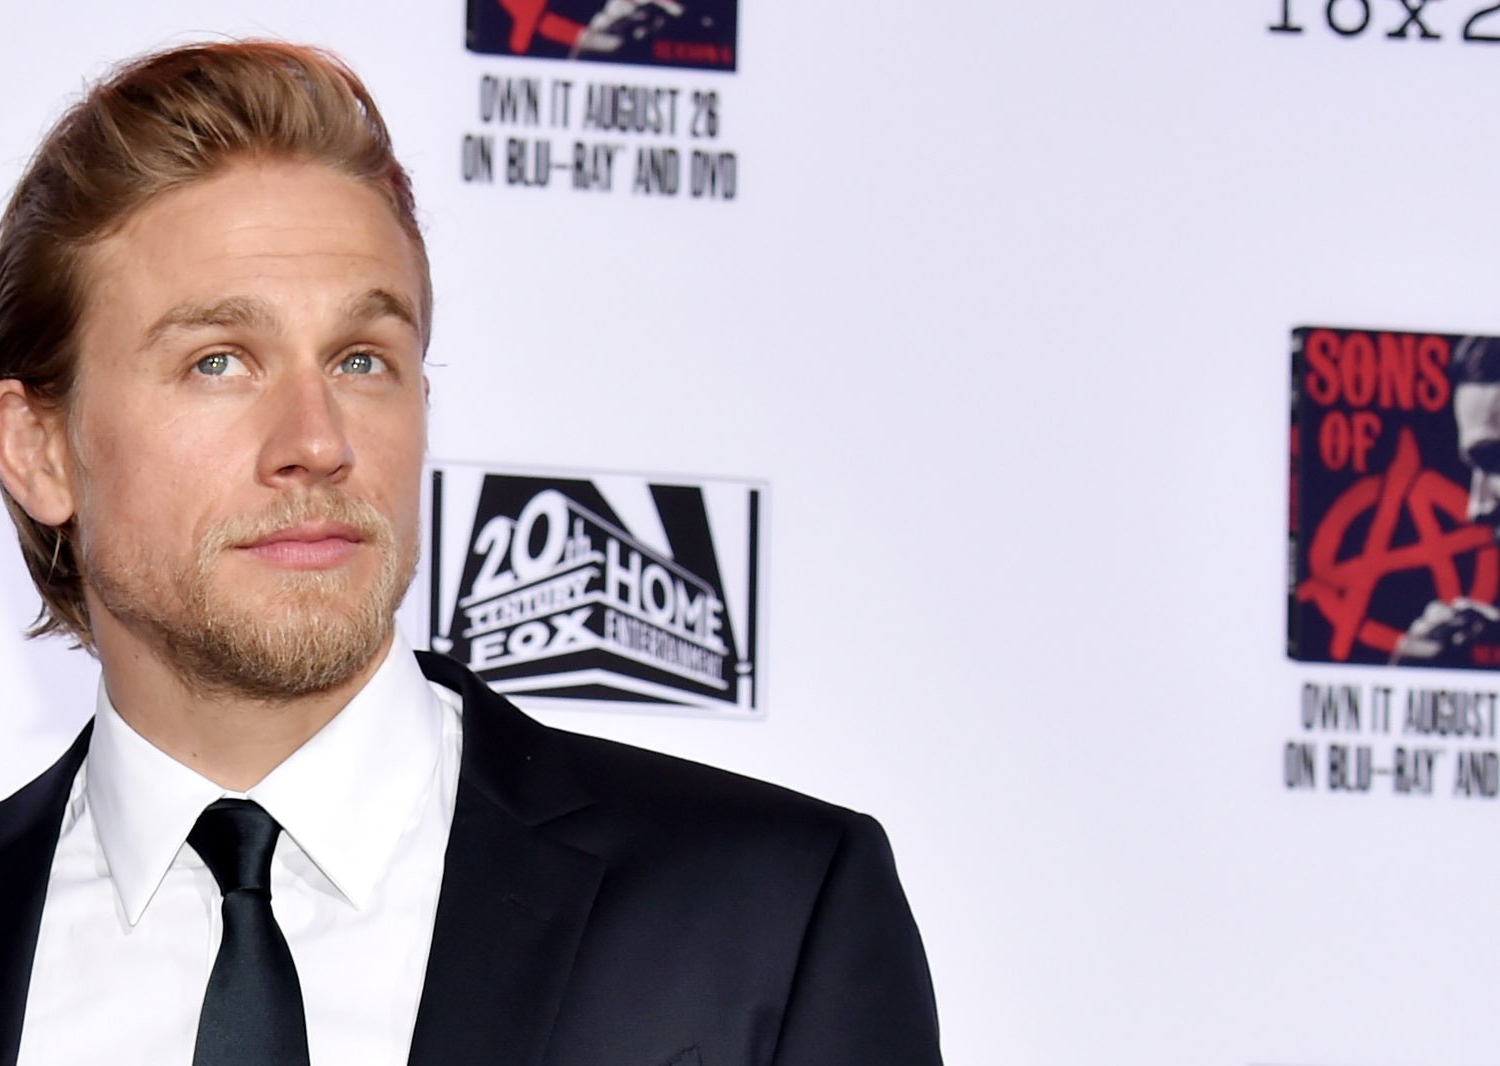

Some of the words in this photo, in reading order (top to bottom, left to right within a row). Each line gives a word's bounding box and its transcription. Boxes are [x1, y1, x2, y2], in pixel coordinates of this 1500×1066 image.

[480, 74, 540, 125] OWN
[550, 79, 574, 128] IT
[583, 83, 681, 136] AUGUST
[690, 89, 719, 138] 26
[462, 134, 494, 184] ON
[633, 145, 680, 196] AND
[690, 149, 736, 200] DVD
[1305, 328, 1451, 413] SONS
[1319, 410, 1383, 473] OF
[473, 489, 595, 600] 20th
[605, 538, 724, 652] HOME
[468, 605, 598, 670] FOX
[1302, 682, 1362, 731] OWN
[1371, 686, 1395, 734] IT
[1402, 688, 1500, 738] AUGUST
[1285, 741, 1316, 789] ON
[1454, 750, 1500, 798] AND
